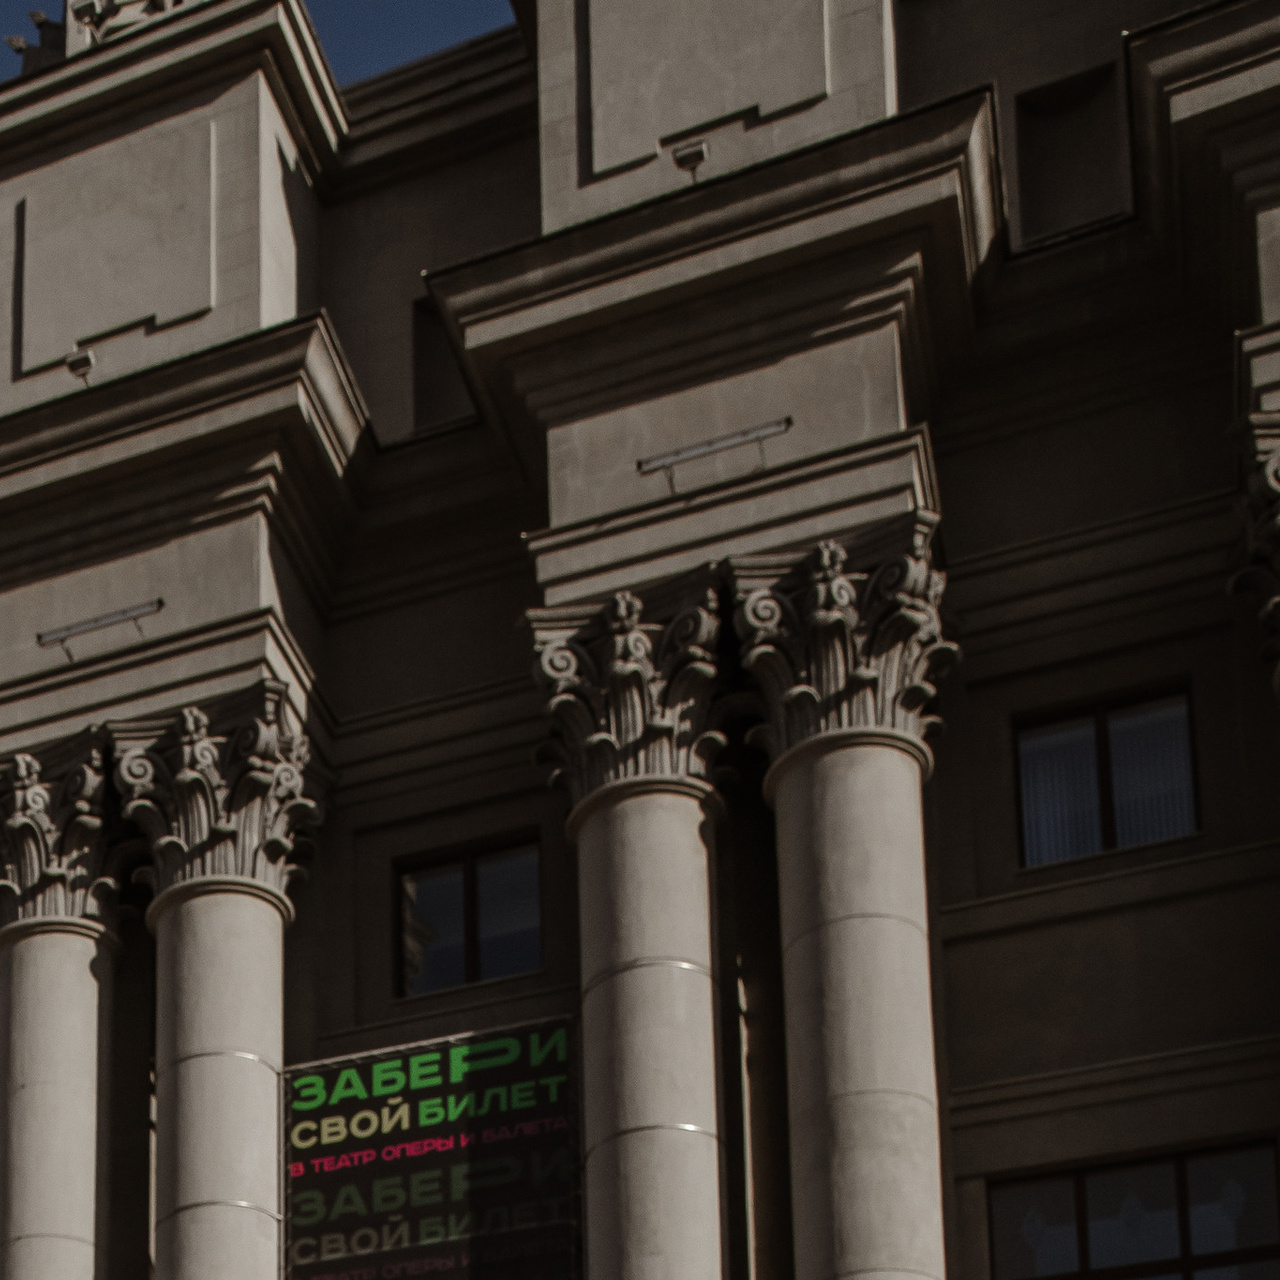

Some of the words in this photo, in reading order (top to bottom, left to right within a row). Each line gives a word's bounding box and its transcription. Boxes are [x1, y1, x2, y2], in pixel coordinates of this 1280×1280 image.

[291, 1028, 568, 1111] ЗАБЕРИ
[290, 1096, 412, 1150] СВОЙ
[418, 1074, 568, 1128] БИЛЕТ
[290, 1162, 305, 1178] В
[311, 1151, 377, 1174] ТЕАТР
[381, 1136, 456, 1161] ОПЕРЫ
[460, 1132, 476, 1149] И
[482, 1117, 569, 1144] БАЛЕТА
[291, 1145, 572, 1227] ЗАБЕРИ
[290, 1216, 412, 1266] СВОЙ
